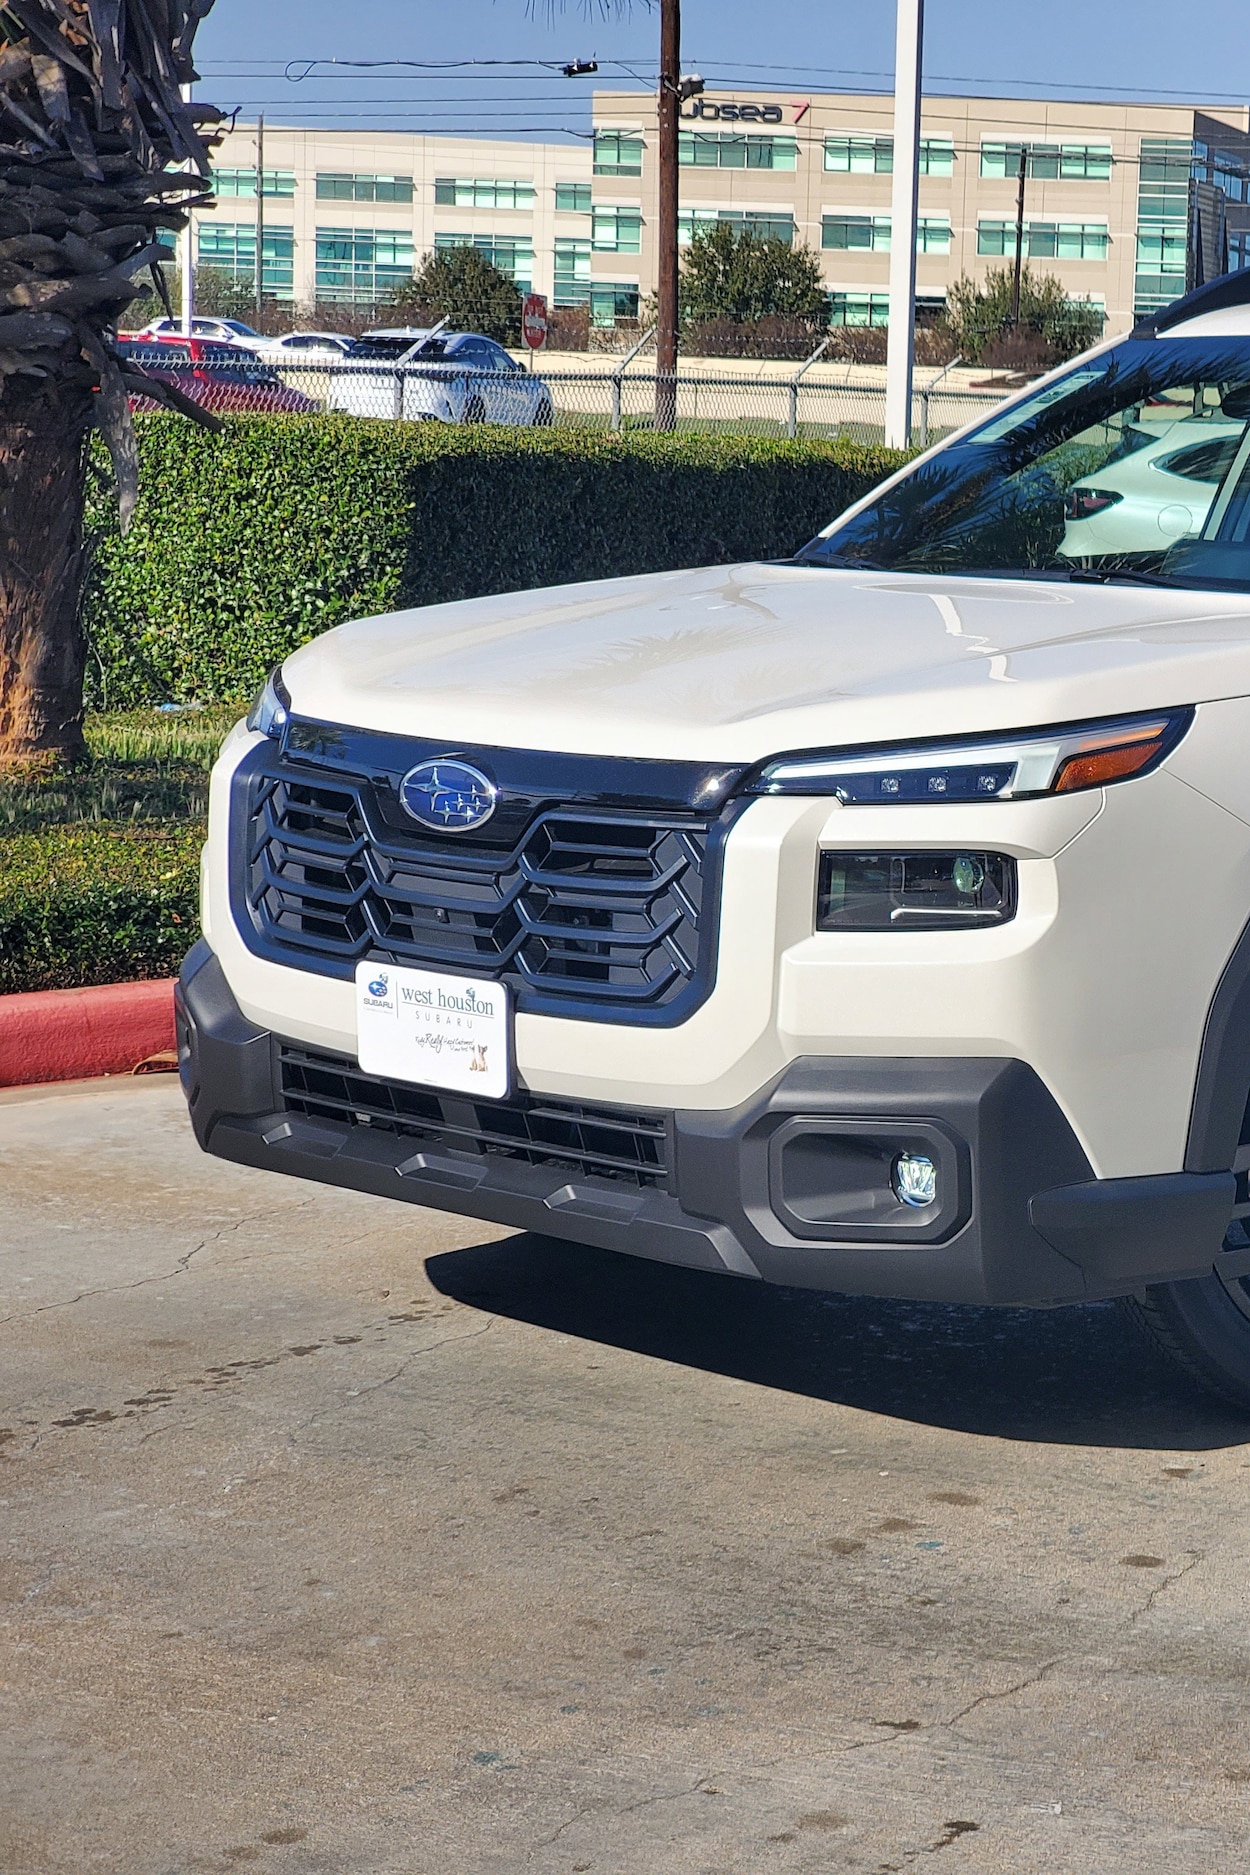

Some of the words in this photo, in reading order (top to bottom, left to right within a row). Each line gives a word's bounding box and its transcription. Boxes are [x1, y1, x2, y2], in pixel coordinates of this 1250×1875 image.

[659, 99, 782, 123] ubsea
[790, 102, 809, 123] 7
[363, 997, 393, 1009] SUBARU
[402, 988, 433, 1005] west
[438, 988, 494, 1016] houston
[415, 1010, 473, 1029] SUBARU
